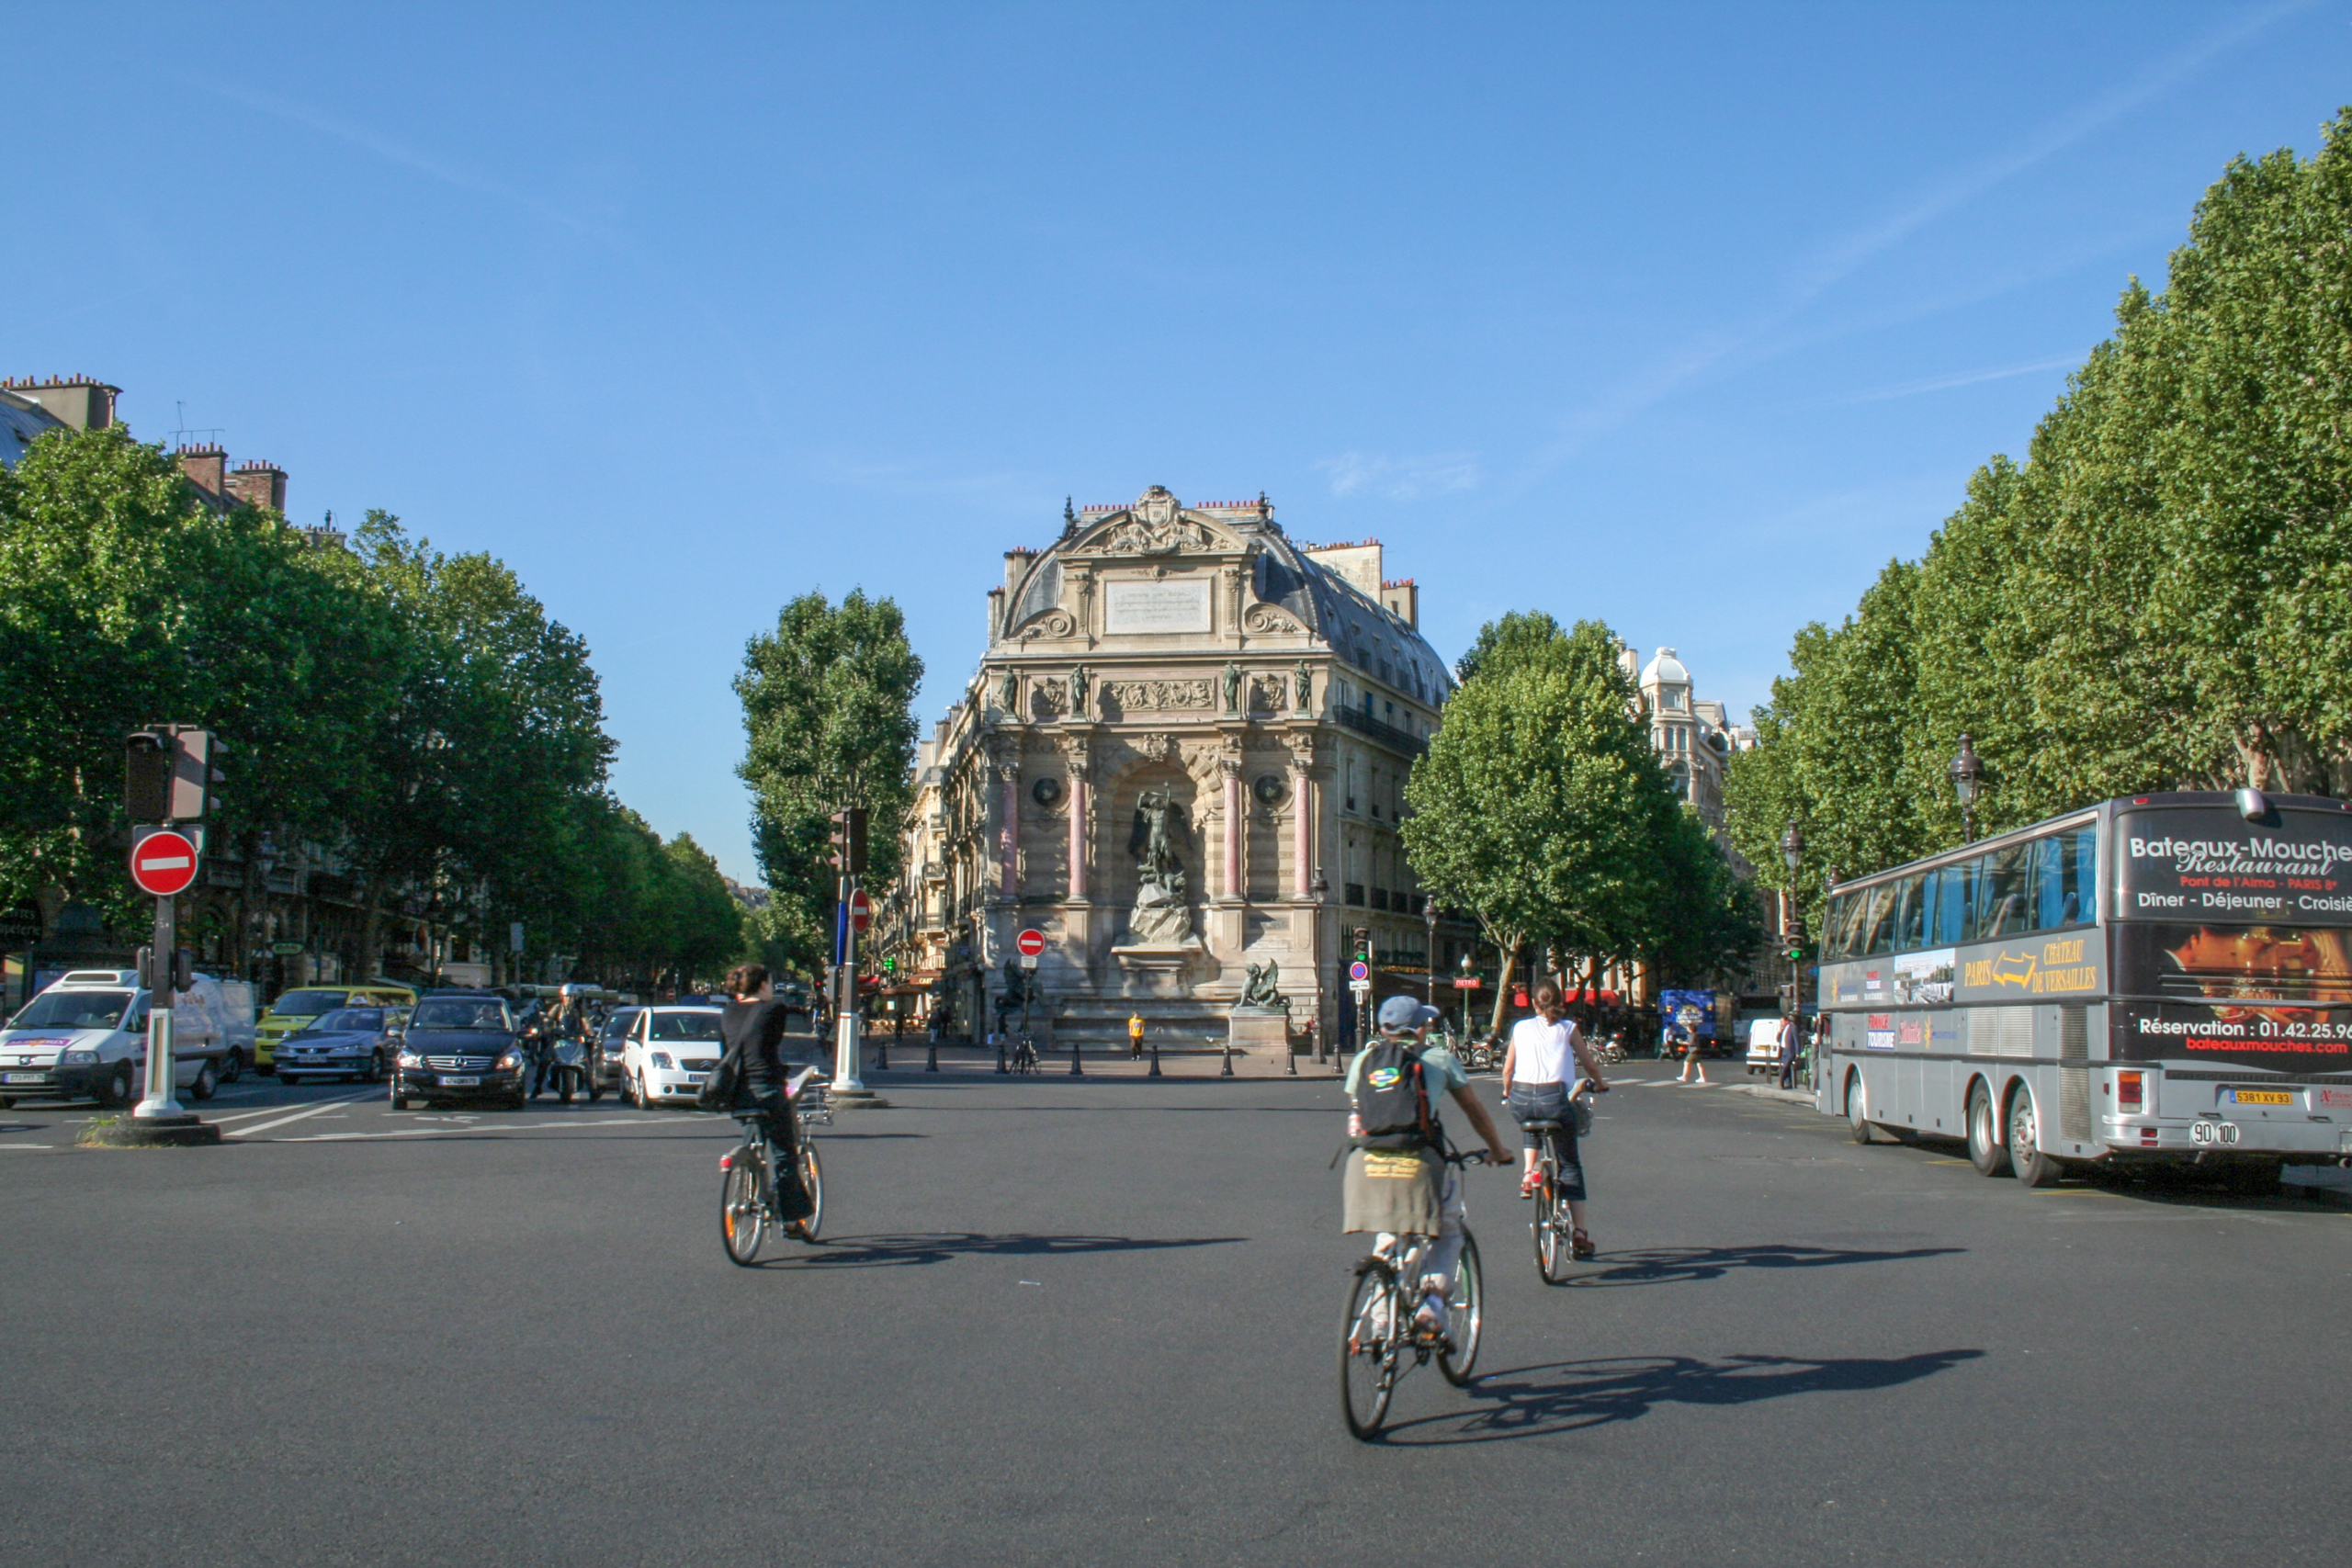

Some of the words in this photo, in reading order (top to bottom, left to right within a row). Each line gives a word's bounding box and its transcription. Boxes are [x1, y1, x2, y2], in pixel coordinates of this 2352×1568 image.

[2175, 850, 2335, 875] Restaurant
[2180, 875, 2210, 887] Pont
[2212, 876, 2231, 887] de
[2233, 876, 2276, 888] l'Alma
[2288, 878, 2322, 890] PARIS
[2138, 892, 2185, 908] Dîner
[2202, 892, 2281, 910] Déjeuner
[1964, 960, 1991, 987] PARIS
[2032, 972, 2044, 993] DE
[2045, 966, 2097, 992] VERSAILLES
[1868, 1014, 1889, 1029] FRANCE
[2139, 1019, 2245, 1036] Réservation
[1868, 1032, 1894, 1047] TOURISME
[2186, 1037, 2348, 1054] bateauxmouches.com
[2236, 1091, 2261, 1102] 5381
[2263, 1093, 2275, 1102] XV
[2278, 1094, 2290, 1103] 93
[2194, 1123, 2212, 1143] 90
[2218, 1124, 2236, 1144] 100
